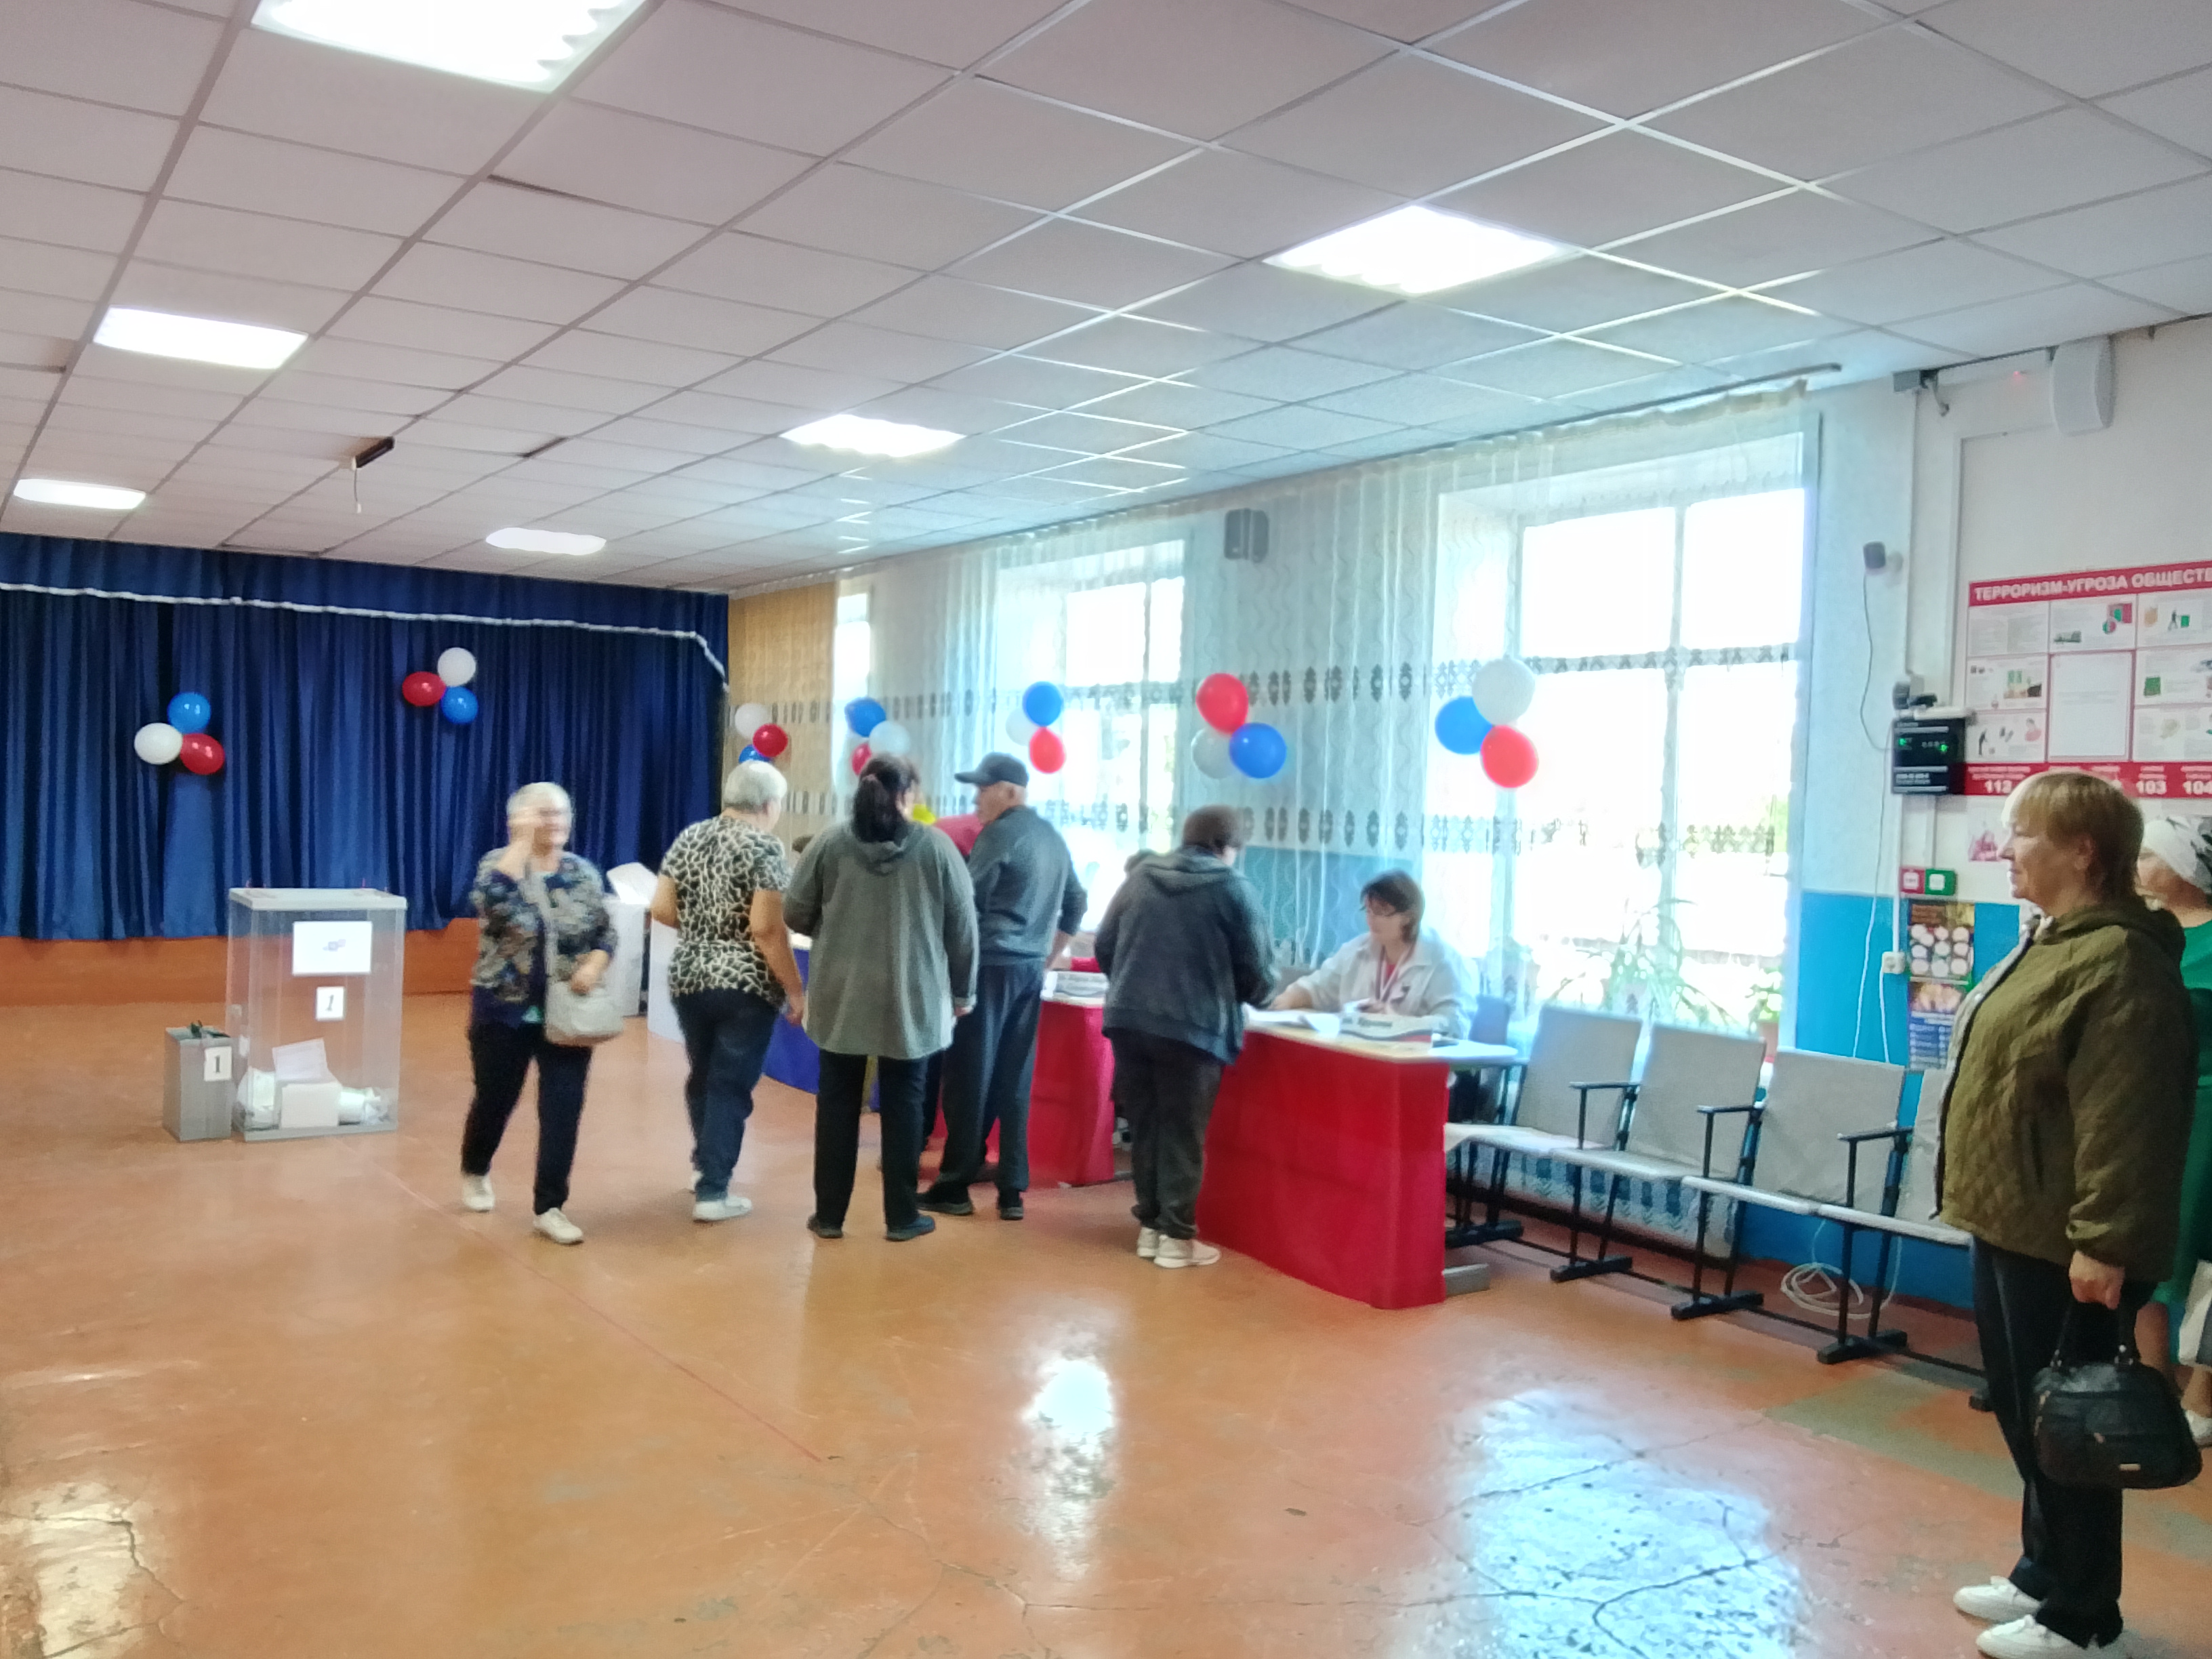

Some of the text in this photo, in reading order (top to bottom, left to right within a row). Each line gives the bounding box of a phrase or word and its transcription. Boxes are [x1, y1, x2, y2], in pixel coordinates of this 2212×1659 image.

[1975, 575, 2127, 601] ТЕРРОРИЗМ-УГРОЗА
[1984, 779, 2012, 794] 112
[2136, 780, 2167, 795] 103
[325, 994, 334, 1012] 1
[214, 1054, 221, 1073] 1
